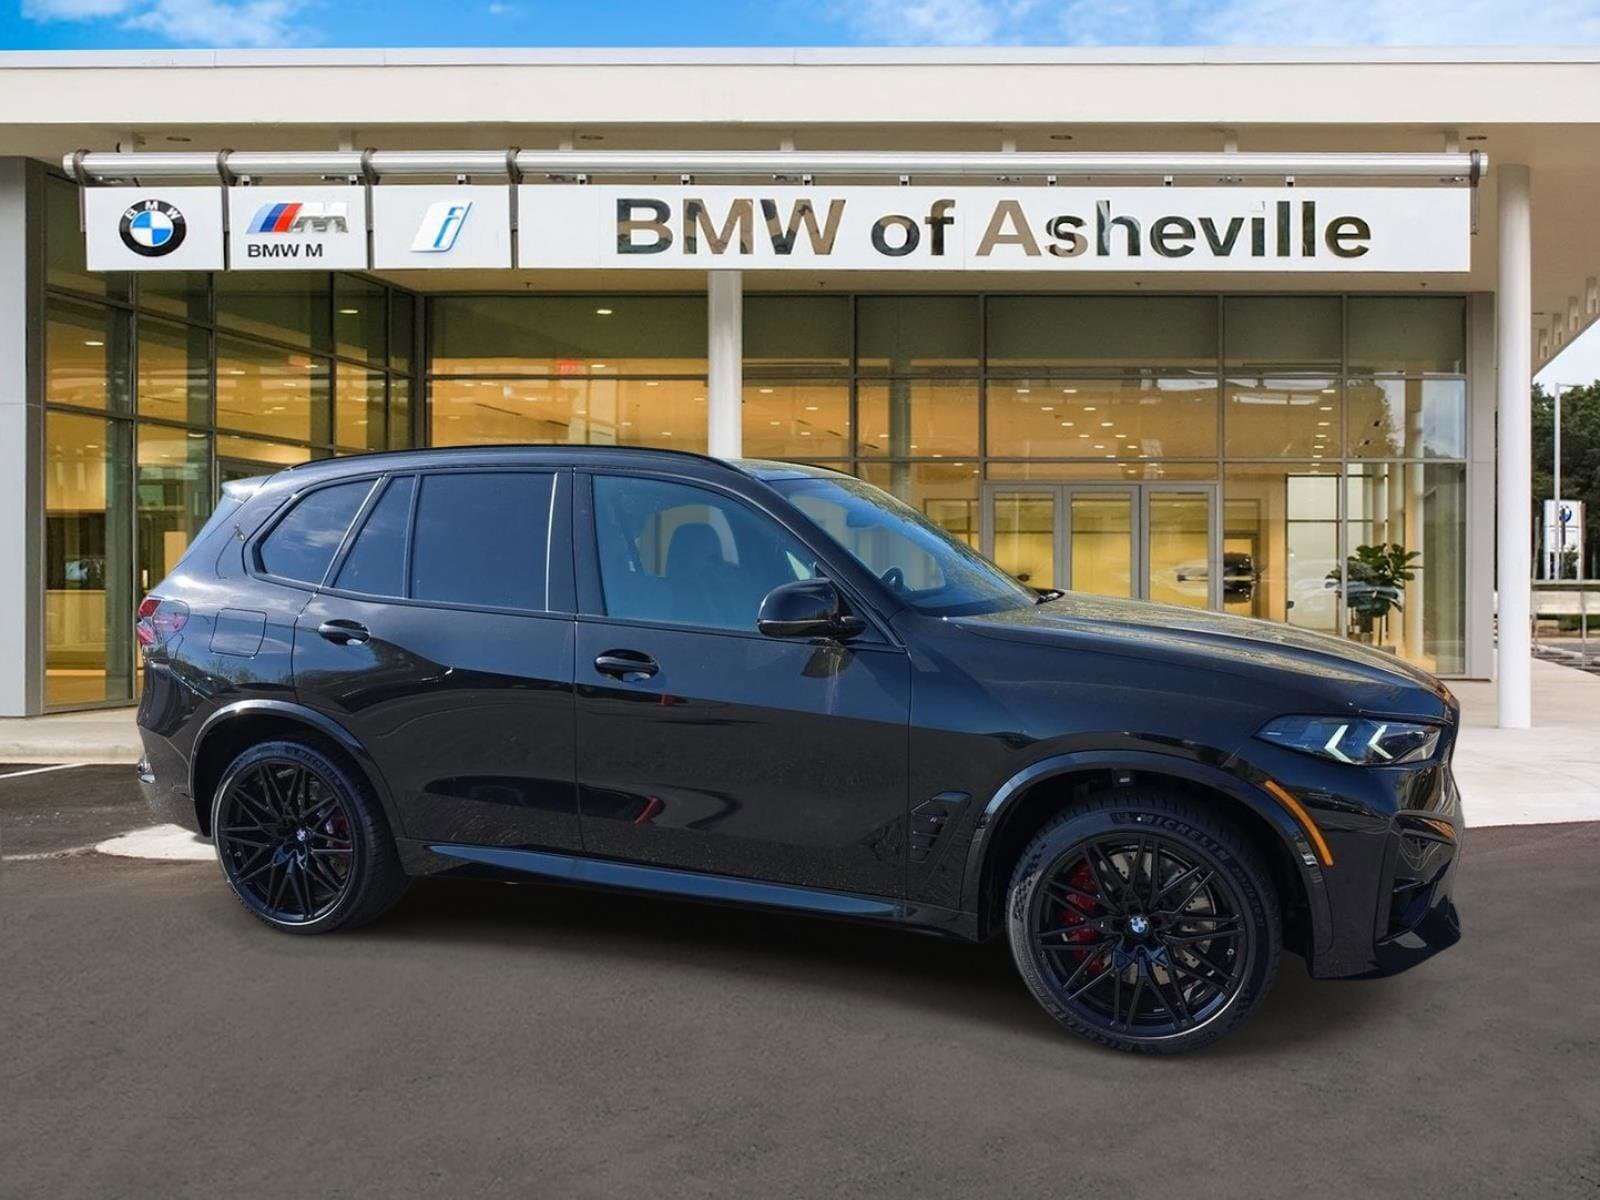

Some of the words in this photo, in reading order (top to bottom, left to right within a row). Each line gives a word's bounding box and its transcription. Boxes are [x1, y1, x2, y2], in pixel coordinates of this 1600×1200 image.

[125, 200, 181, 220] BMW
[616, 198, 847, 255] BMW
[870, 198, 956, 257] of
[975, 199, 1372, 258] Asheville
[247, 243, 300, 258] BMW
[305, 243, 323, 258] M
